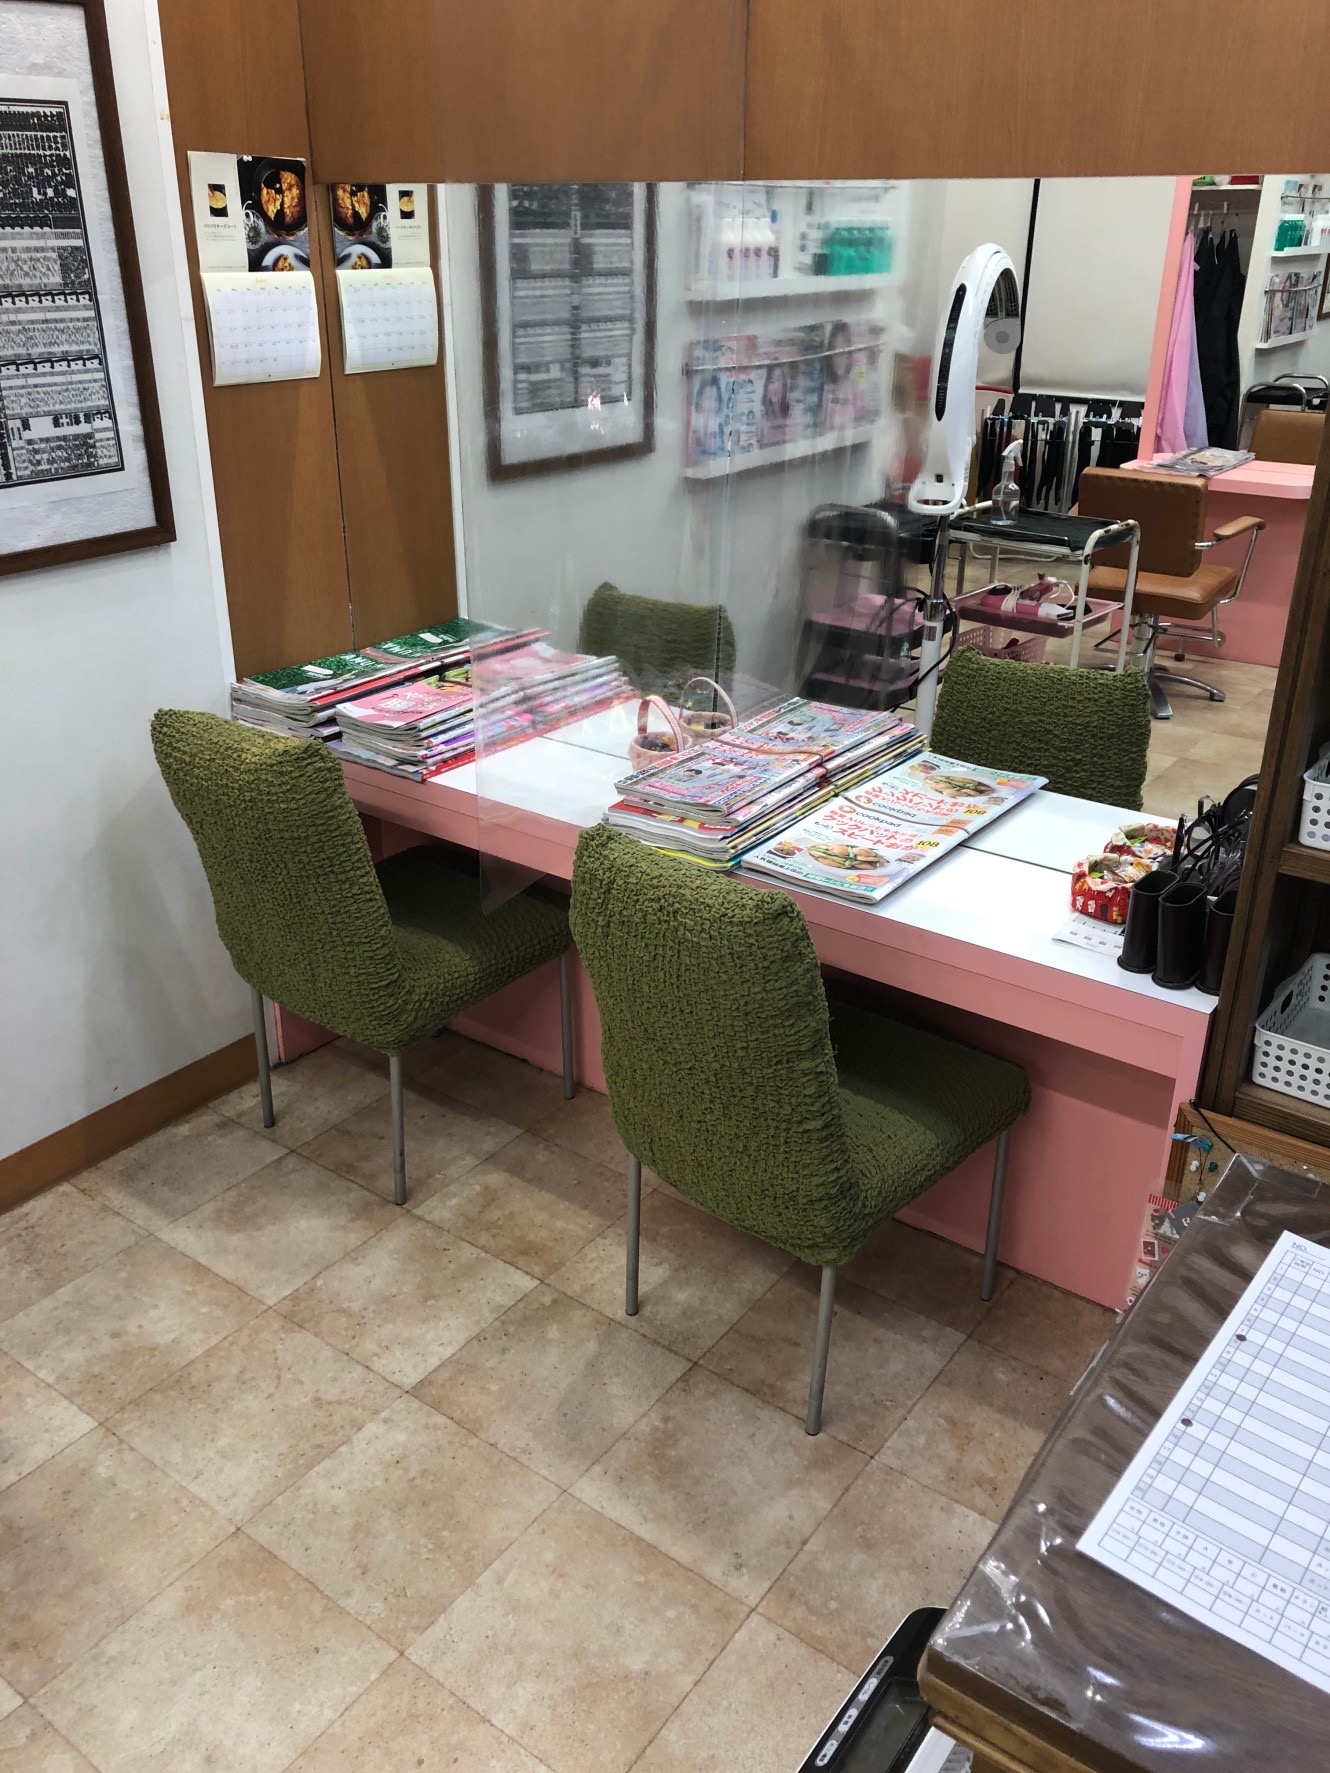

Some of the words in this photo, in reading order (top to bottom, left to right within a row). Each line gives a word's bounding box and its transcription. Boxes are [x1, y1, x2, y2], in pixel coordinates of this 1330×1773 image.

[242, 200, 254, 225] 6
[855, 811, 902, 828] cookpad
[916, 840, 940, 848] 108
[1292, 1241, 1308, 1253] NO.
